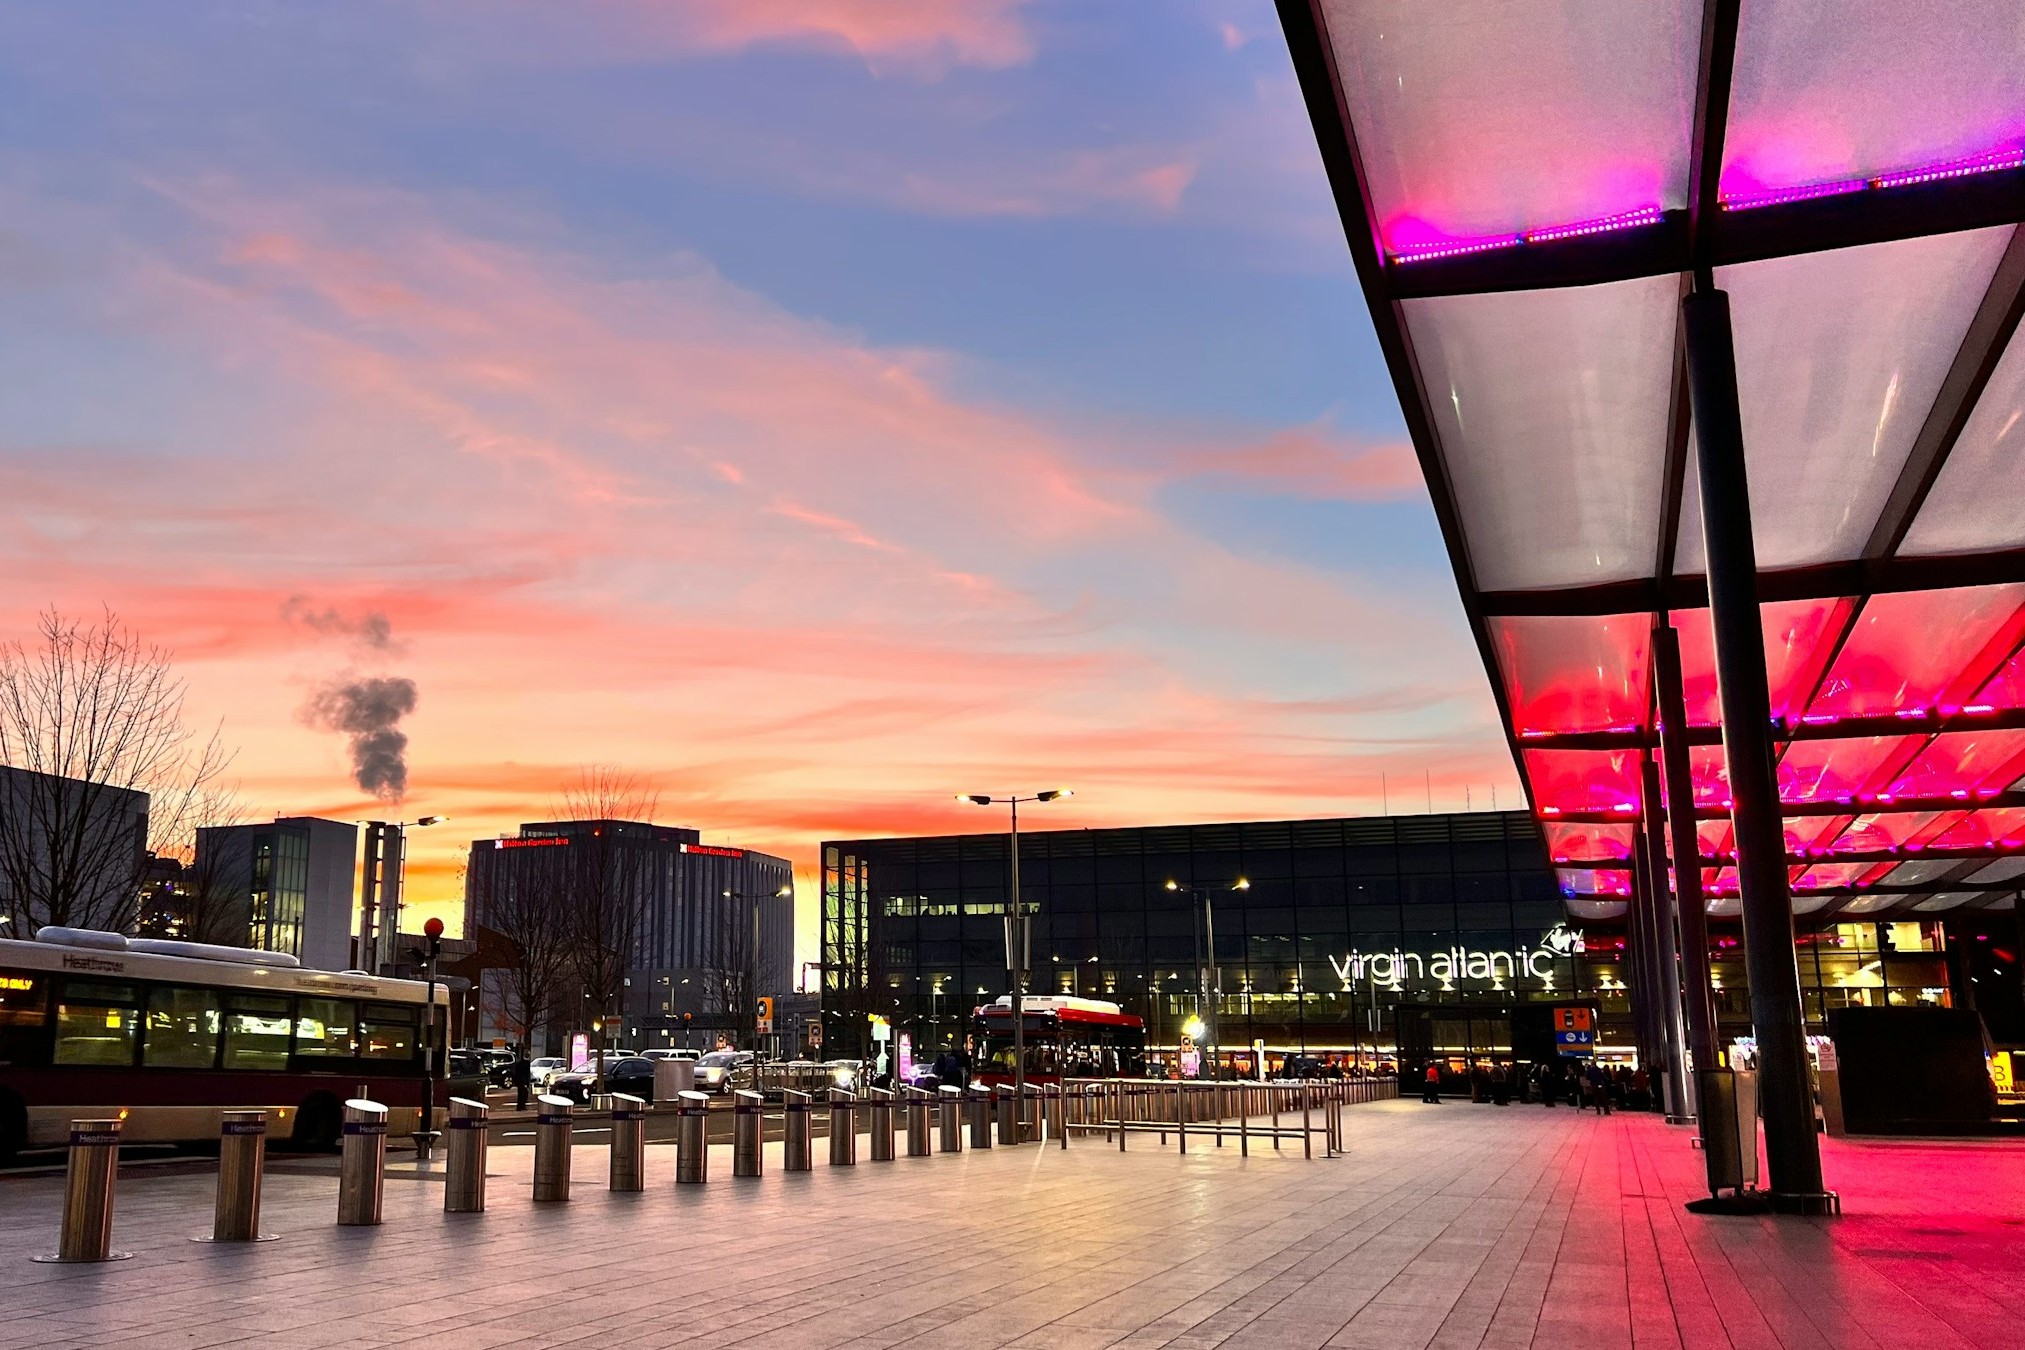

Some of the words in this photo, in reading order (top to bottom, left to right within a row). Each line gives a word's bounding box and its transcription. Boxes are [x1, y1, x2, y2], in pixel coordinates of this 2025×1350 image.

[528, 838, 554, 847] Garden
[555, 837, 569, 846] Inn
[708, 848, 730, 857] Garden
[731, 849, 743, 858] Inn
[1328, 946, 1423, 986] virgin
[230, 1123, 265, 1133] Heathro
[79, 1133, 119, 1143] Heathro
